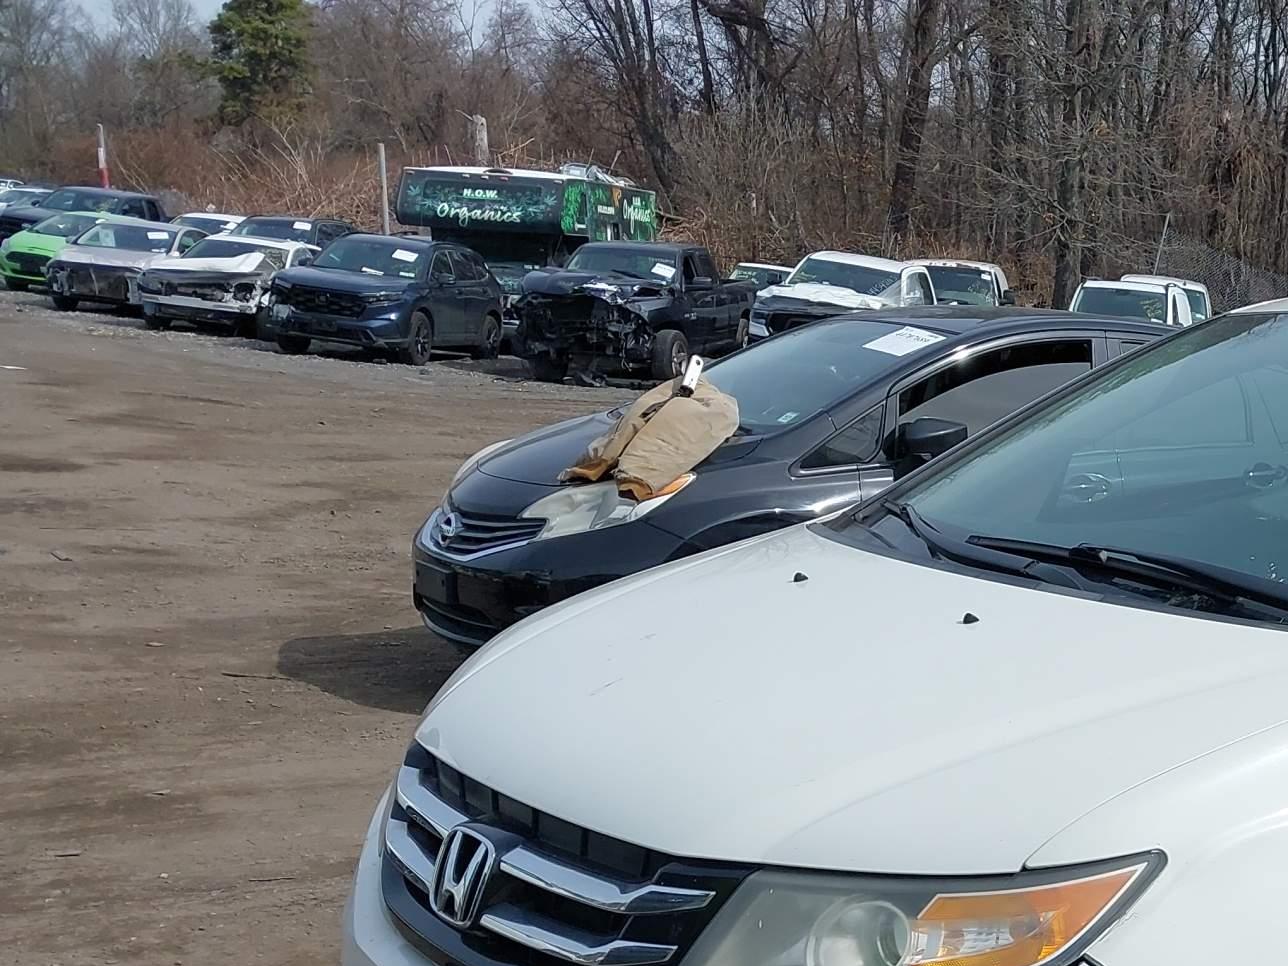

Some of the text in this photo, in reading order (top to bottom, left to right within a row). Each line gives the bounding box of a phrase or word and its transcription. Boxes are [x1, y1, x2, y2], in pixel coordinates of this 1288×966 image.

[463, 188, 498, 198] H.O.W.
[436, 202, 522, 227] Organics
[622, 198, 651, 235] Organics
